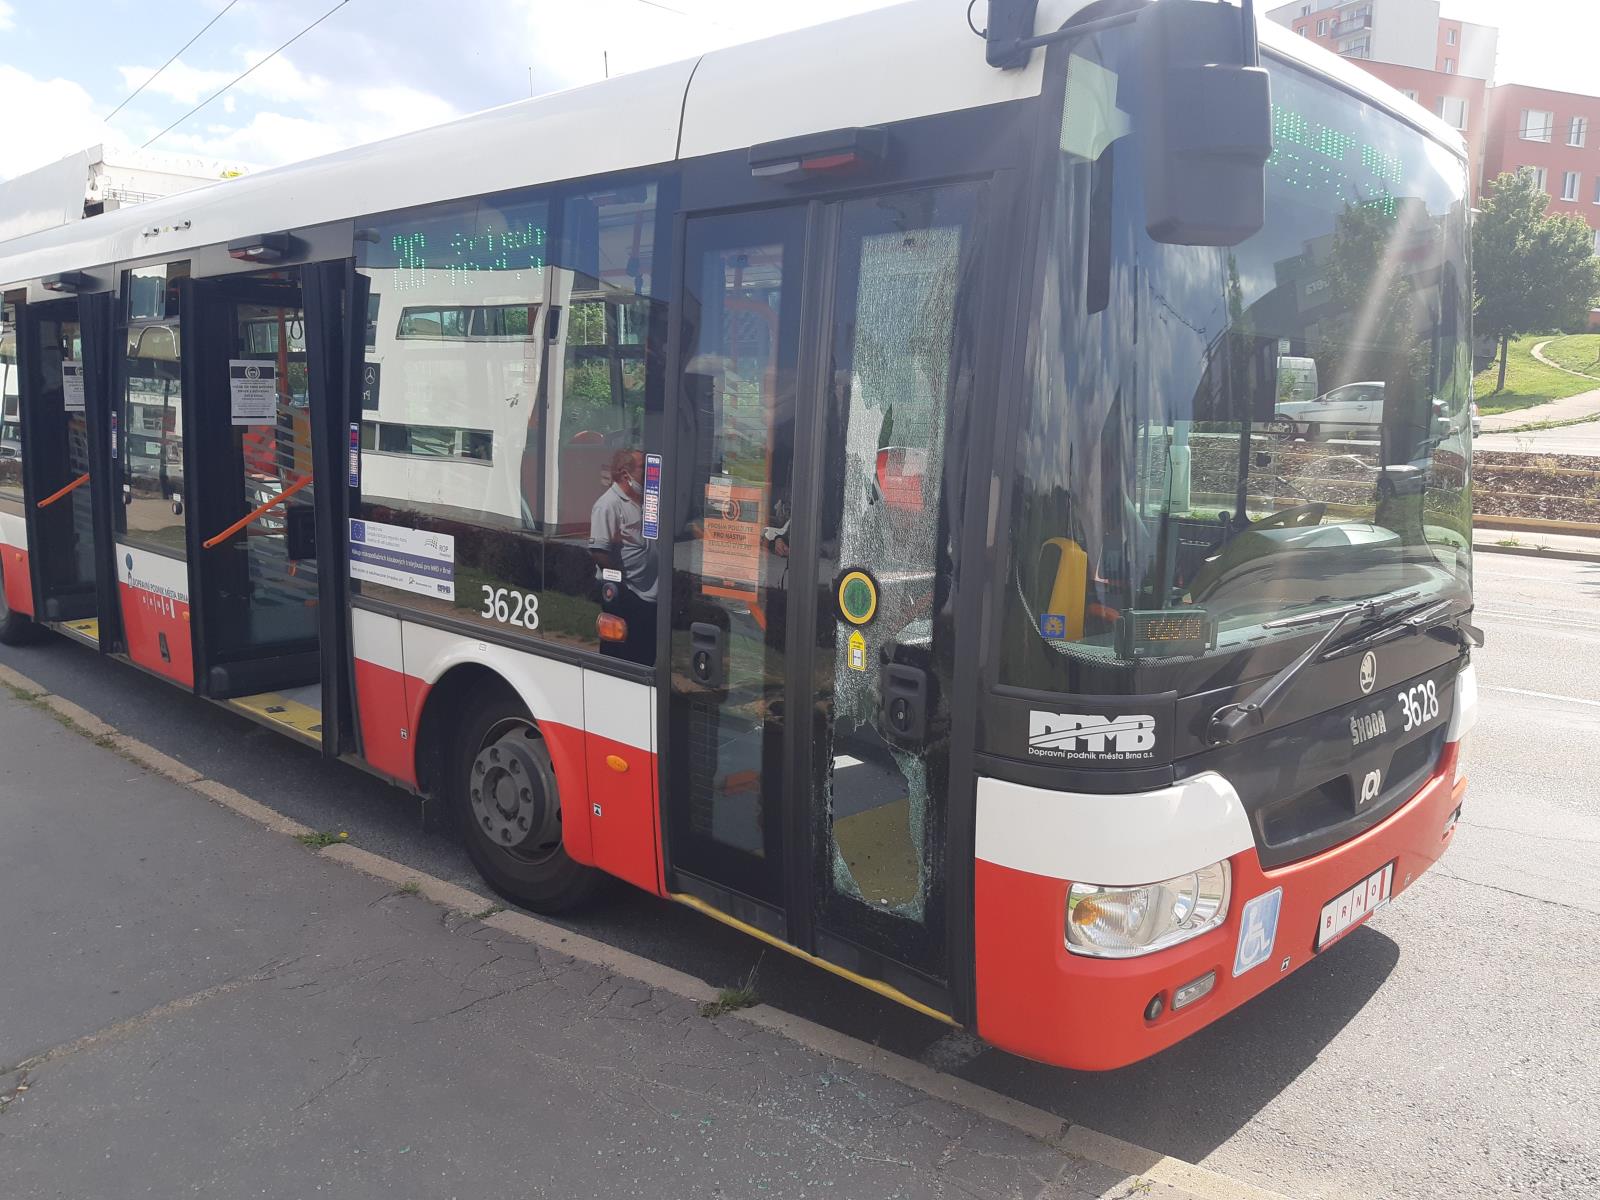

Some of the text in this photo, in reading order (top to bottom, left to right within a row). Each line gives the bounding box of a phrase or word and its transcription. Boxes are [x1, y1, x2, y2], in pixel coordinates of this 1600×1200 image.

[481, 585, 539, 630] 3628
[1397, 680, 1439, 732] 3628
[1028, 710, 1156, 752] DPMB
[1350, 709, 1387, 746] ŠKODA
[1028, 747, 1066, 759] Dopravní
[1067, 751, 1097, 760] podnik
[1098, 752, 1124, 760] města
[1125, 752, 1142, 760] Brna
